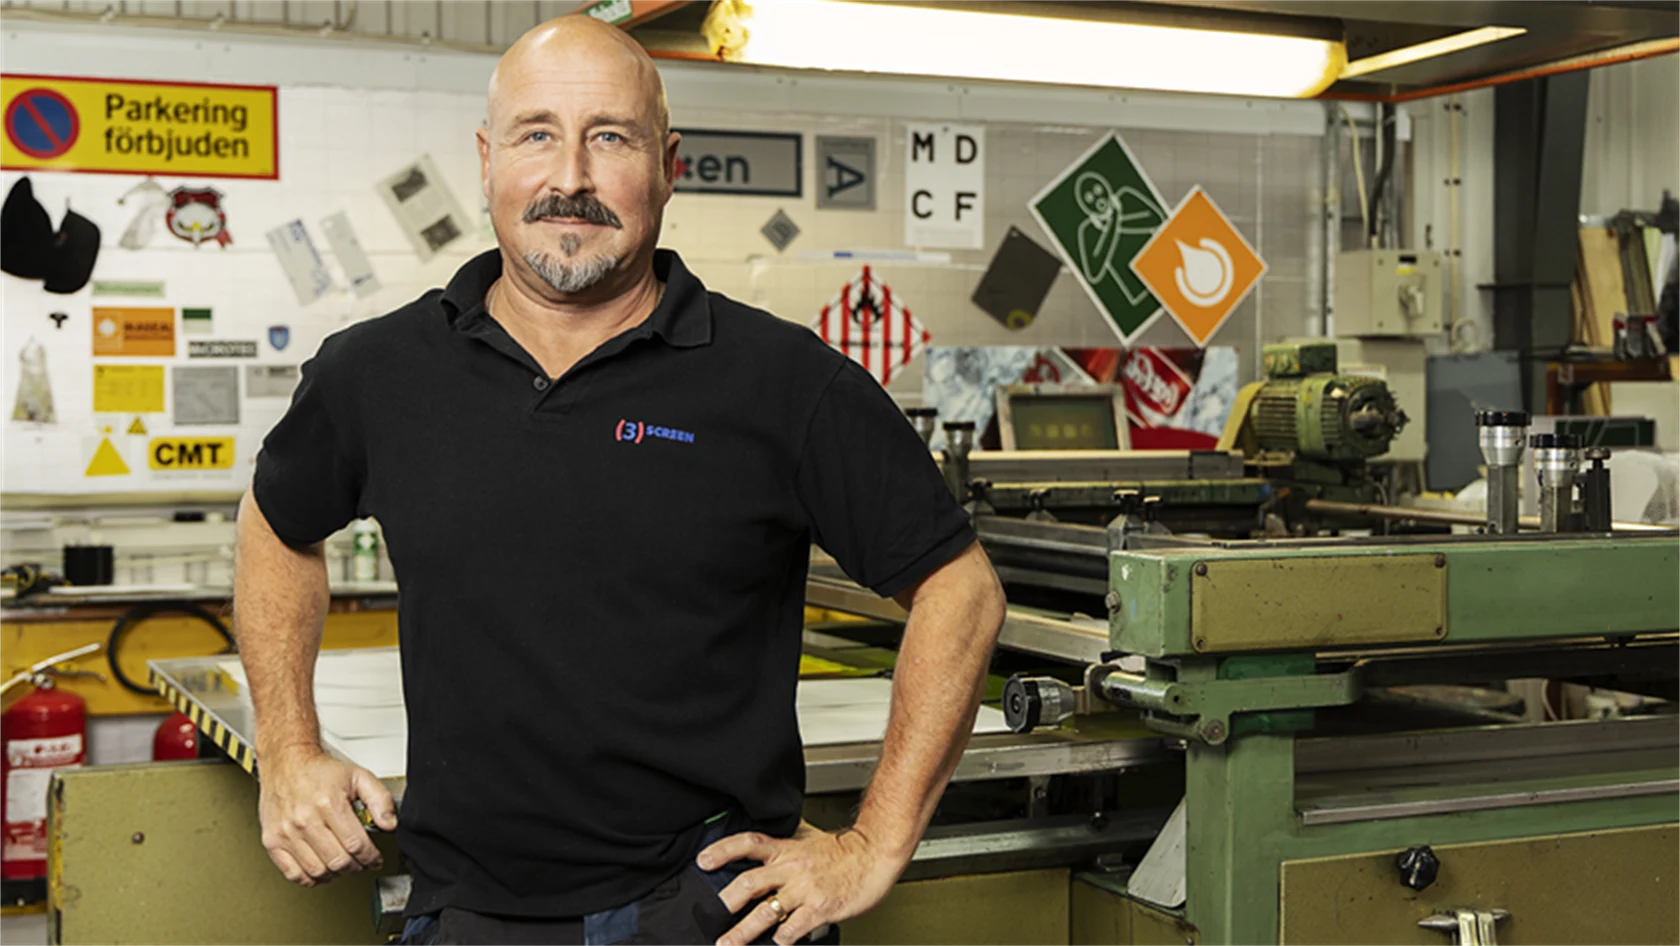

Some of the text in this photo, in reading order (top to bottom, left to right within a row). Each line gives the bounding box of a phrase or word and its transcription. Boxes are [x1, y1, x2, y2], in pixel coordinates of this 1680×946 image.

[105, 94, 247, 132] Parkering
[105, 126, 249, 162] förbjuden
[912, 131, 978, 165] M D
[826, 156, 865, 199] A
[912, 189, 977, 222] C F
[645, 425, 695, 443] SCREEN
[155, 442, 223, 466] CMT
